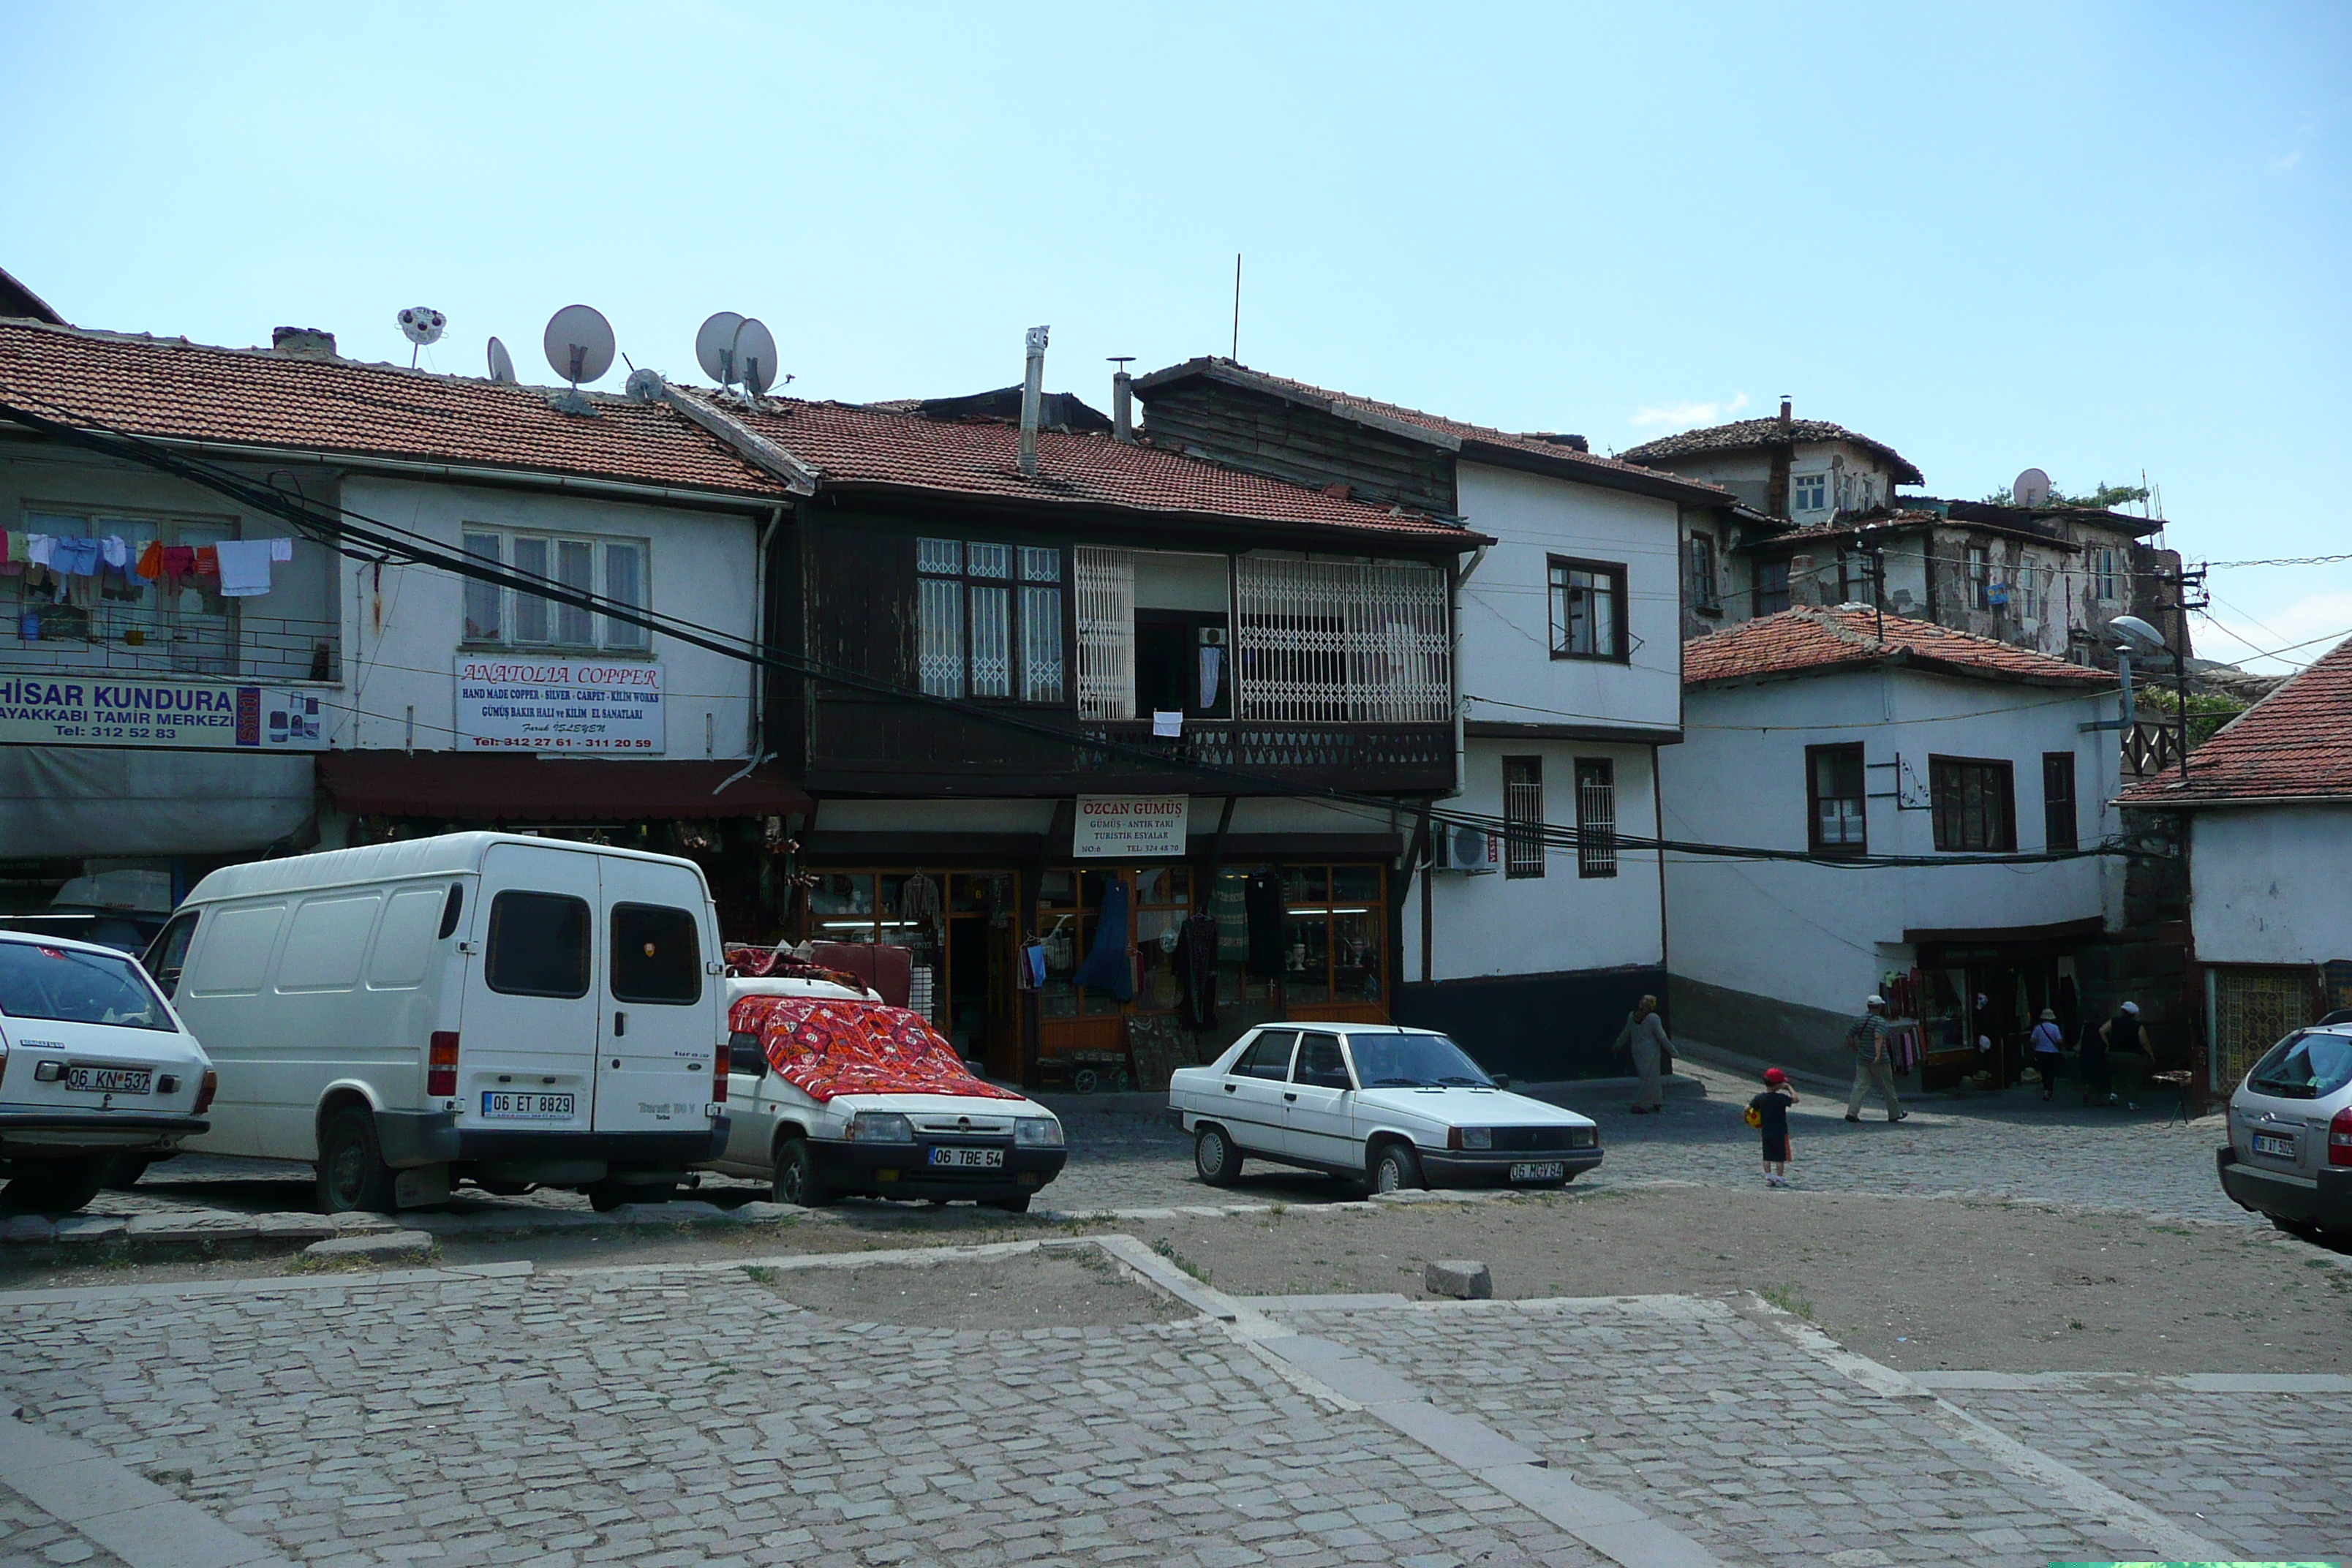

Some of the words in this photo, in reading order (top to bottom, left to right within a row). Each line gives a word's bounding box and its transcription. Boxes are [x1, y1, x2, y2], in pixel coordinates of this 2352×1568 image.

[461, 663, 570, 685] ANATOLIA
[578, 667, 660, 689] COPPER
[0, 678, 83, 706] HİSAR
[94, 686, 233, 712] KUNDURA
[462, 688, 485, 698] HAND
[487, 689, 508, 699] MADE
[510, 690, 539, 700] COPPER
[577, 690, 605, 701] CARPET
[633, 693, 658, 703] WORKS
[0, 707, 88, 722] AYAKKABI
[94, 710, 151, 724] TAMİR
[157, 713, 234, 727] MERKEZİ
[482, 704, 509, 720] GÜMÜŞ
[511, 706, 535, 717] BAKIR
[536, 708, 554, 717] HALI
[565, 706, 587, 718] KİLİM
[592, 709, 600, 717] EL
[602, 709, 643, 719] SANATLARI
[53, 725, 86, 736] Tel:
[91, 727, 123, 737] 312
[129, 728, 150, 738] 52
[155, 728, 176, 739] 83
[472, 738, 499, 746] Tel:
[504, 738, 530, 747] 312
[556, 739, 571, 747] 61
[585, 739, 609, 747] 311
[614, 739, 630, 747] 20
[635, 739, 652, 747] 59
[1083, 799, 1130, 815] ÖZCAN
[1134, 799, 1182, 818] GÜMÜŞ
[1090, 818, 1121, 829] GÜMÜŞ
[1134, 831, 1169, 840] EŞYALAR
[69, 1069, 88, 1085] 06
[96, 1071, 117, 1088] KN
[124, 1072, 150, 1088] 537
[494, 1096, 509, 1110] 06
[517, 1096, 532, 1111] ET
[540, 1097, 570, 1112] 8829
[936, 1149, 951, 1164] 06
[960, 1150, 982, 1165] TBE
[986, 1152, 1001, 1166] 54
[1512, 1165, 1525, 1177] 06
[1550, 1163, 1562, 1176] 84
